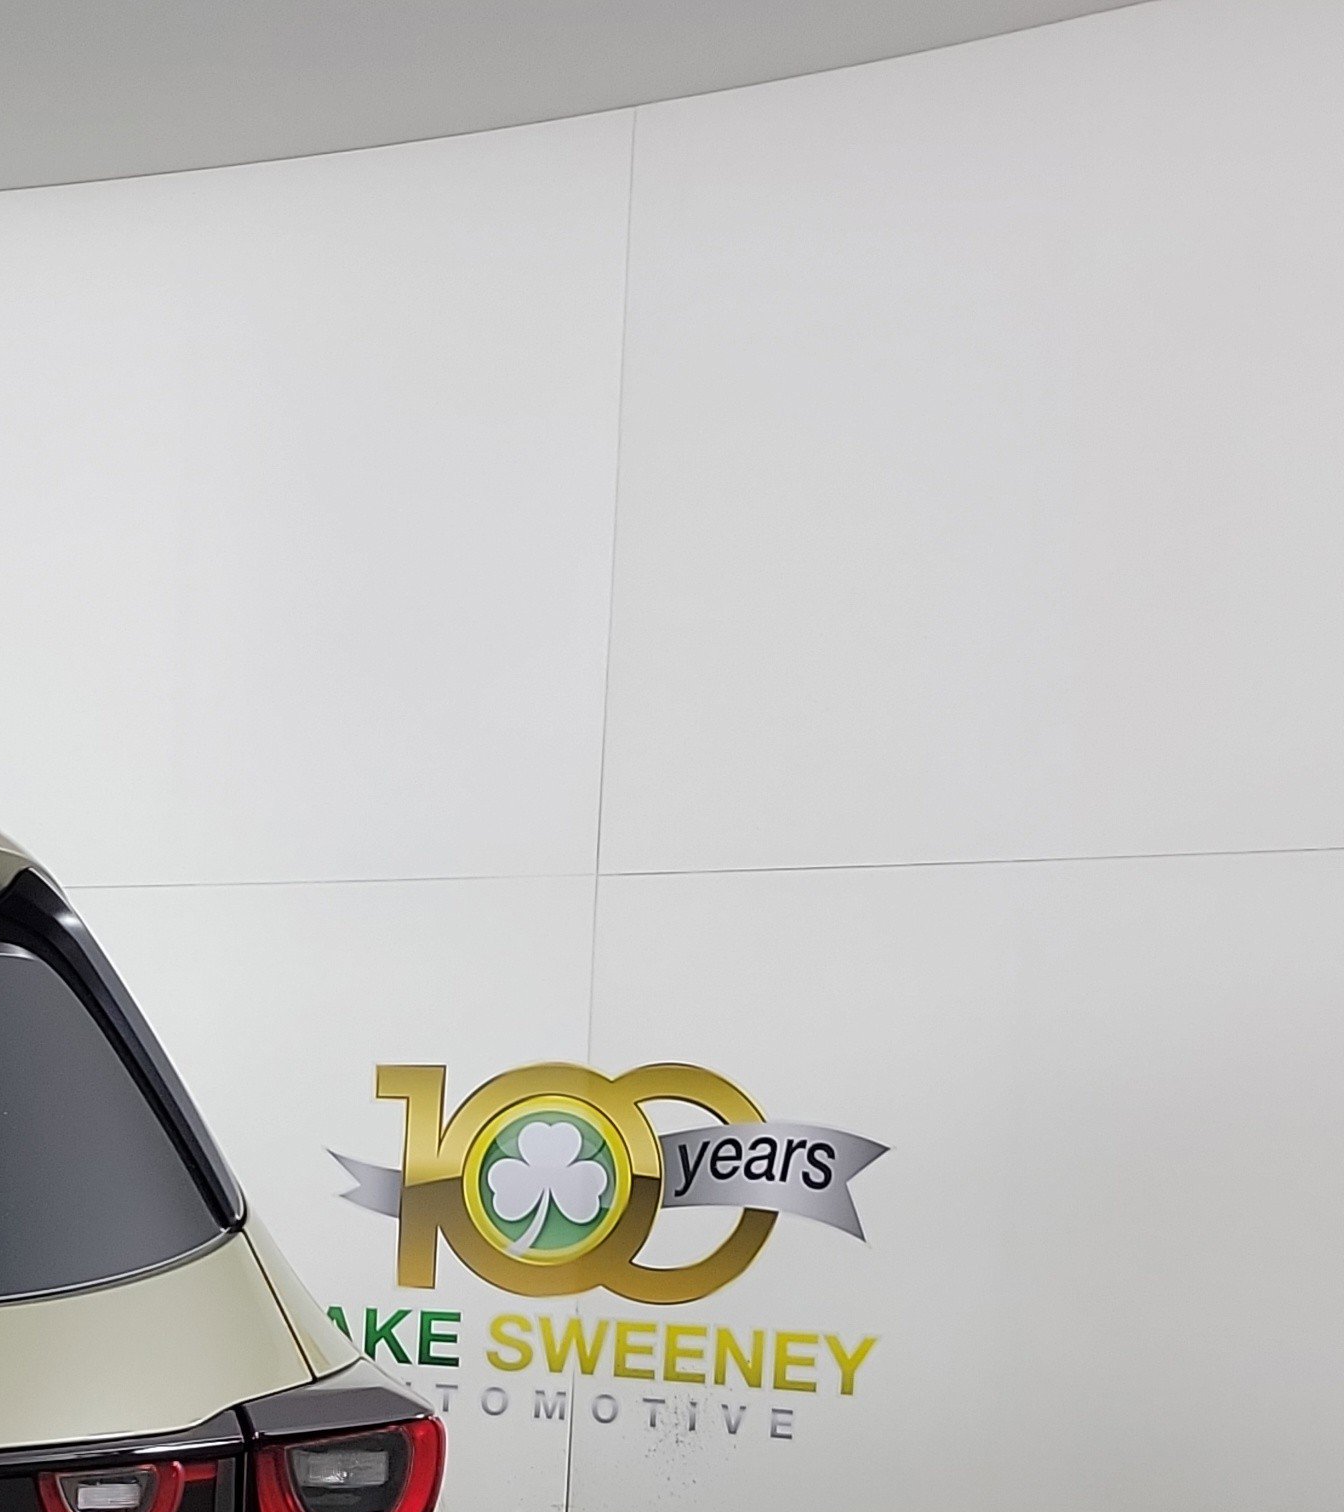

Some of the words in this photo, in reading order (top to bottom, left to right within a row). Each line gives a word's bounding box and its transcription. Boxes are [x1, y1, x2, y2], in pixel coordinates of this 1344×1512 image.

[376, 1063, 779, 1304] 100
[674, 1137, 835, 1198] years
[486, 1314, 878, 1396] SWEENEY
[406, 1382, 794, 1439] TOMOTIVE
